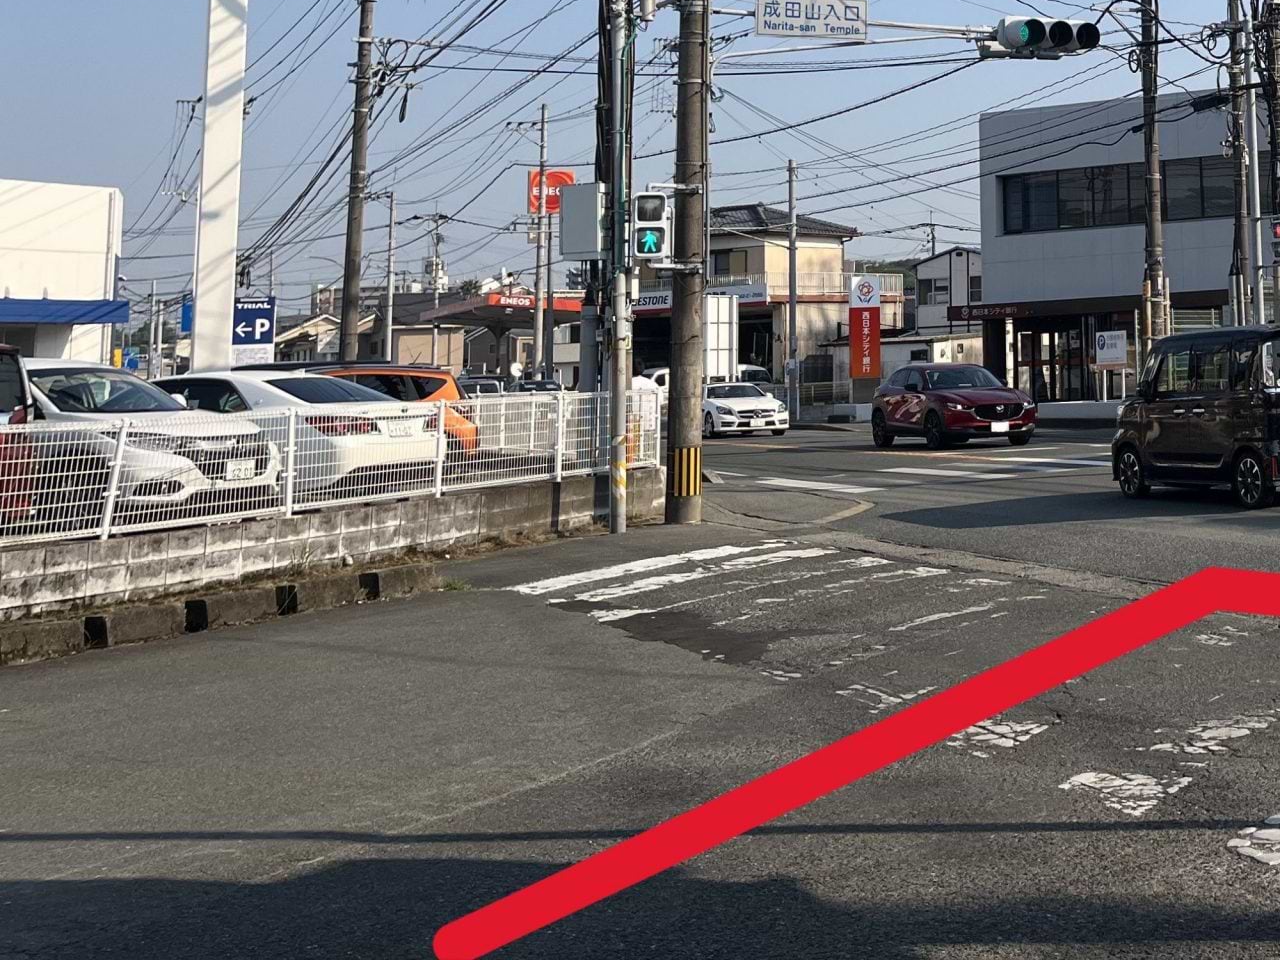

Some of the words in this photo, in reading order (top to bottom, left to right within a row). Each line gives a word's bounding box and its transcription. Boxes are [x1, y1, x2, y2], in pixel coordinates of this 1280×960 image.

[763, 0, 860, 21] 成田山入口
[763, 20, 816, 33] Narita-san
[824, 23, 860, 35] Temple
[500, 296, 531, 306] ENEOS
[255, 318, 271, 340] P
